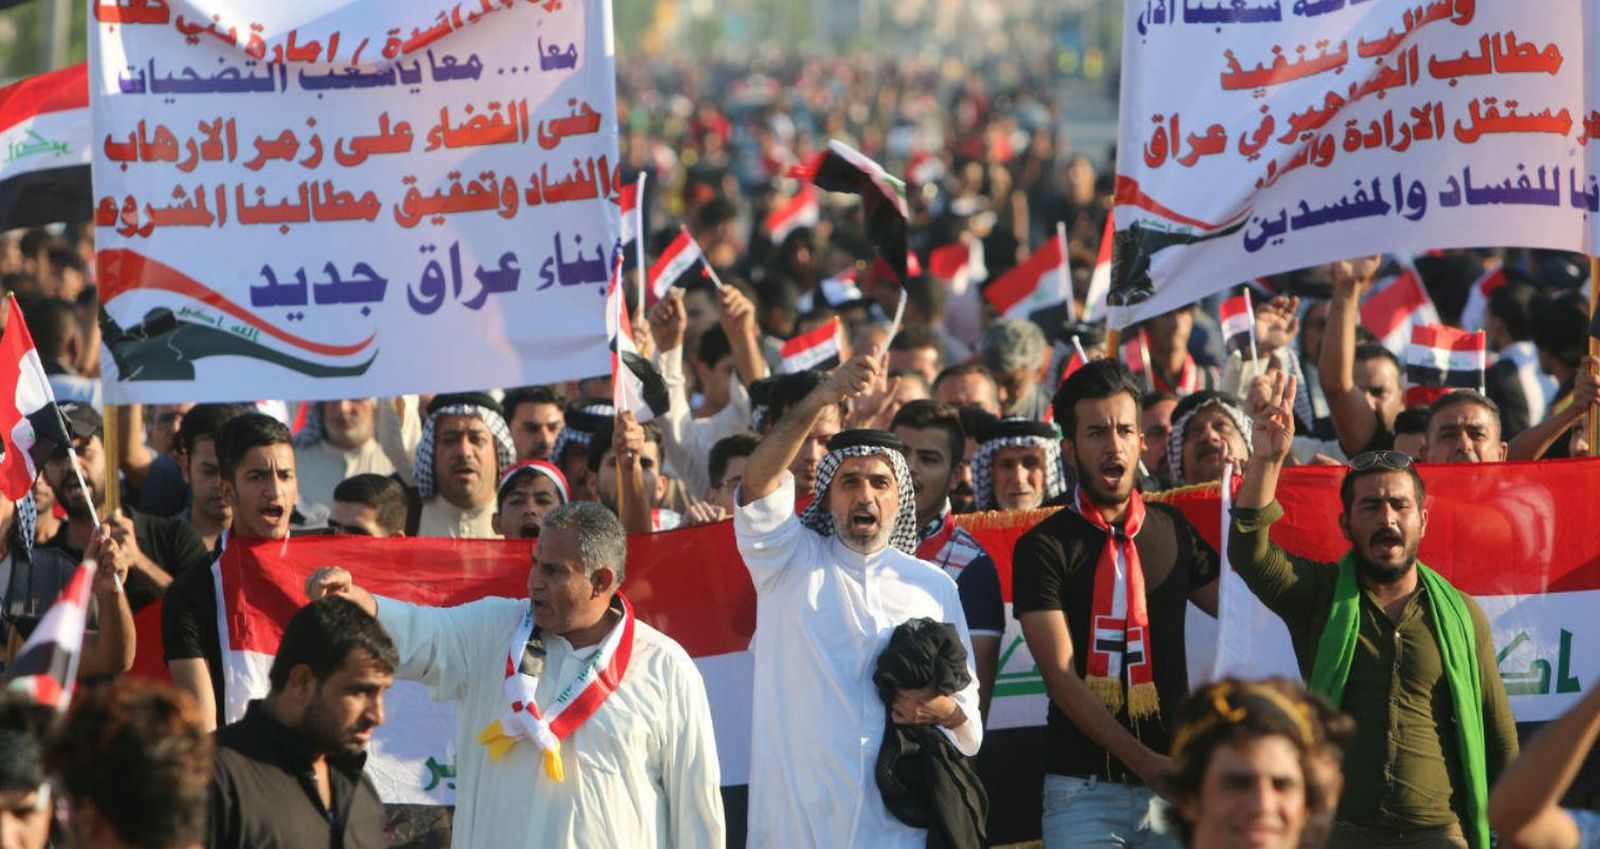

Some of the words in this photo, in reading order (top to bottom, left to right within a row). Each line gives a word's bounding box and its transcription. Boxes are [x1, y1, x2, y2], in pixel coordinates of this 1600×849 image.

[118, 57, 287, 103] التضحيات
[1220, 40, 1348, 98] بتنفيذ
[1428, 31, 1563, 87] مطالب
[1277, 44, 1419, 144] الجاهير
[1454, 97, 1573, 144] مستقل
[104, 117, 238, 173] الارهاب
[243, 116, 323, 171] زمر
[336, 112, 414, 167] على
[424, 98, 529, 152] القضاء
[537, 97, 601, 150] حتى
[1144, 113, 1228, 168] عراق
[1239, 104, 1275, 162] في
[1343, 102, 1445, 152] الارادة
[235, 179, 382, 234] مطالبنا
[394, 170, 519, 228] وتحقيق
[1244, 172, 1427, 252] والمفسدين
[1439, 163, 1560, 207] للفساد
[249, 262, 388, 322] جديد
[407, 241, 521, 315] عراق
